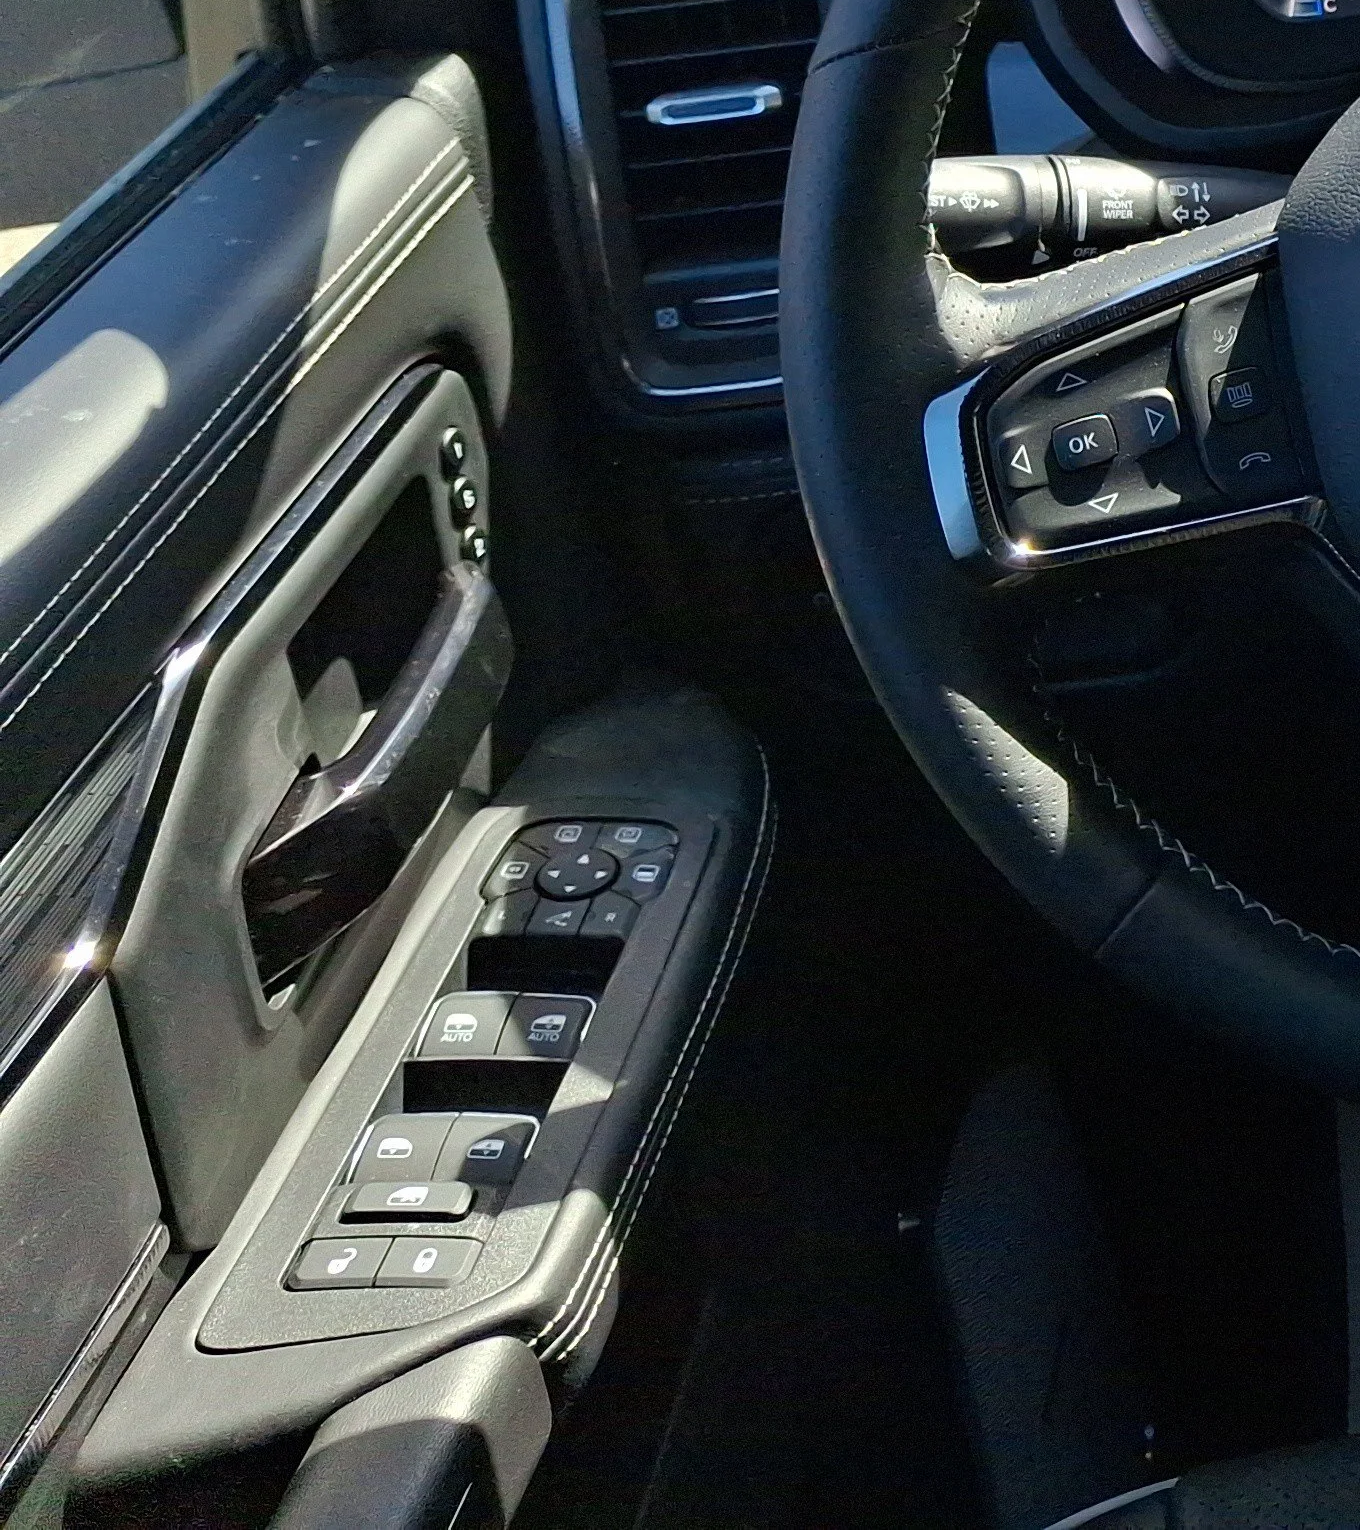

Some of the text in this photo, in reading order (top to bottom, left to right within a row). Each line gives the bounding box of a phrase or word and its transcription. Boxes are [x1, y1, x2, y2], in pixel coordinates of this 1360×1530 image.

[1102, 200, 1133, 209] FRONT
[1103, 209, 1133, 219] WIPER
[1073, 247, 1098, 258] OFF
[1068, 432, 1099, 455] OK
[440, 1031, 474, 1044] AUTO
[527, 1031, 560, 1043] AUTO
